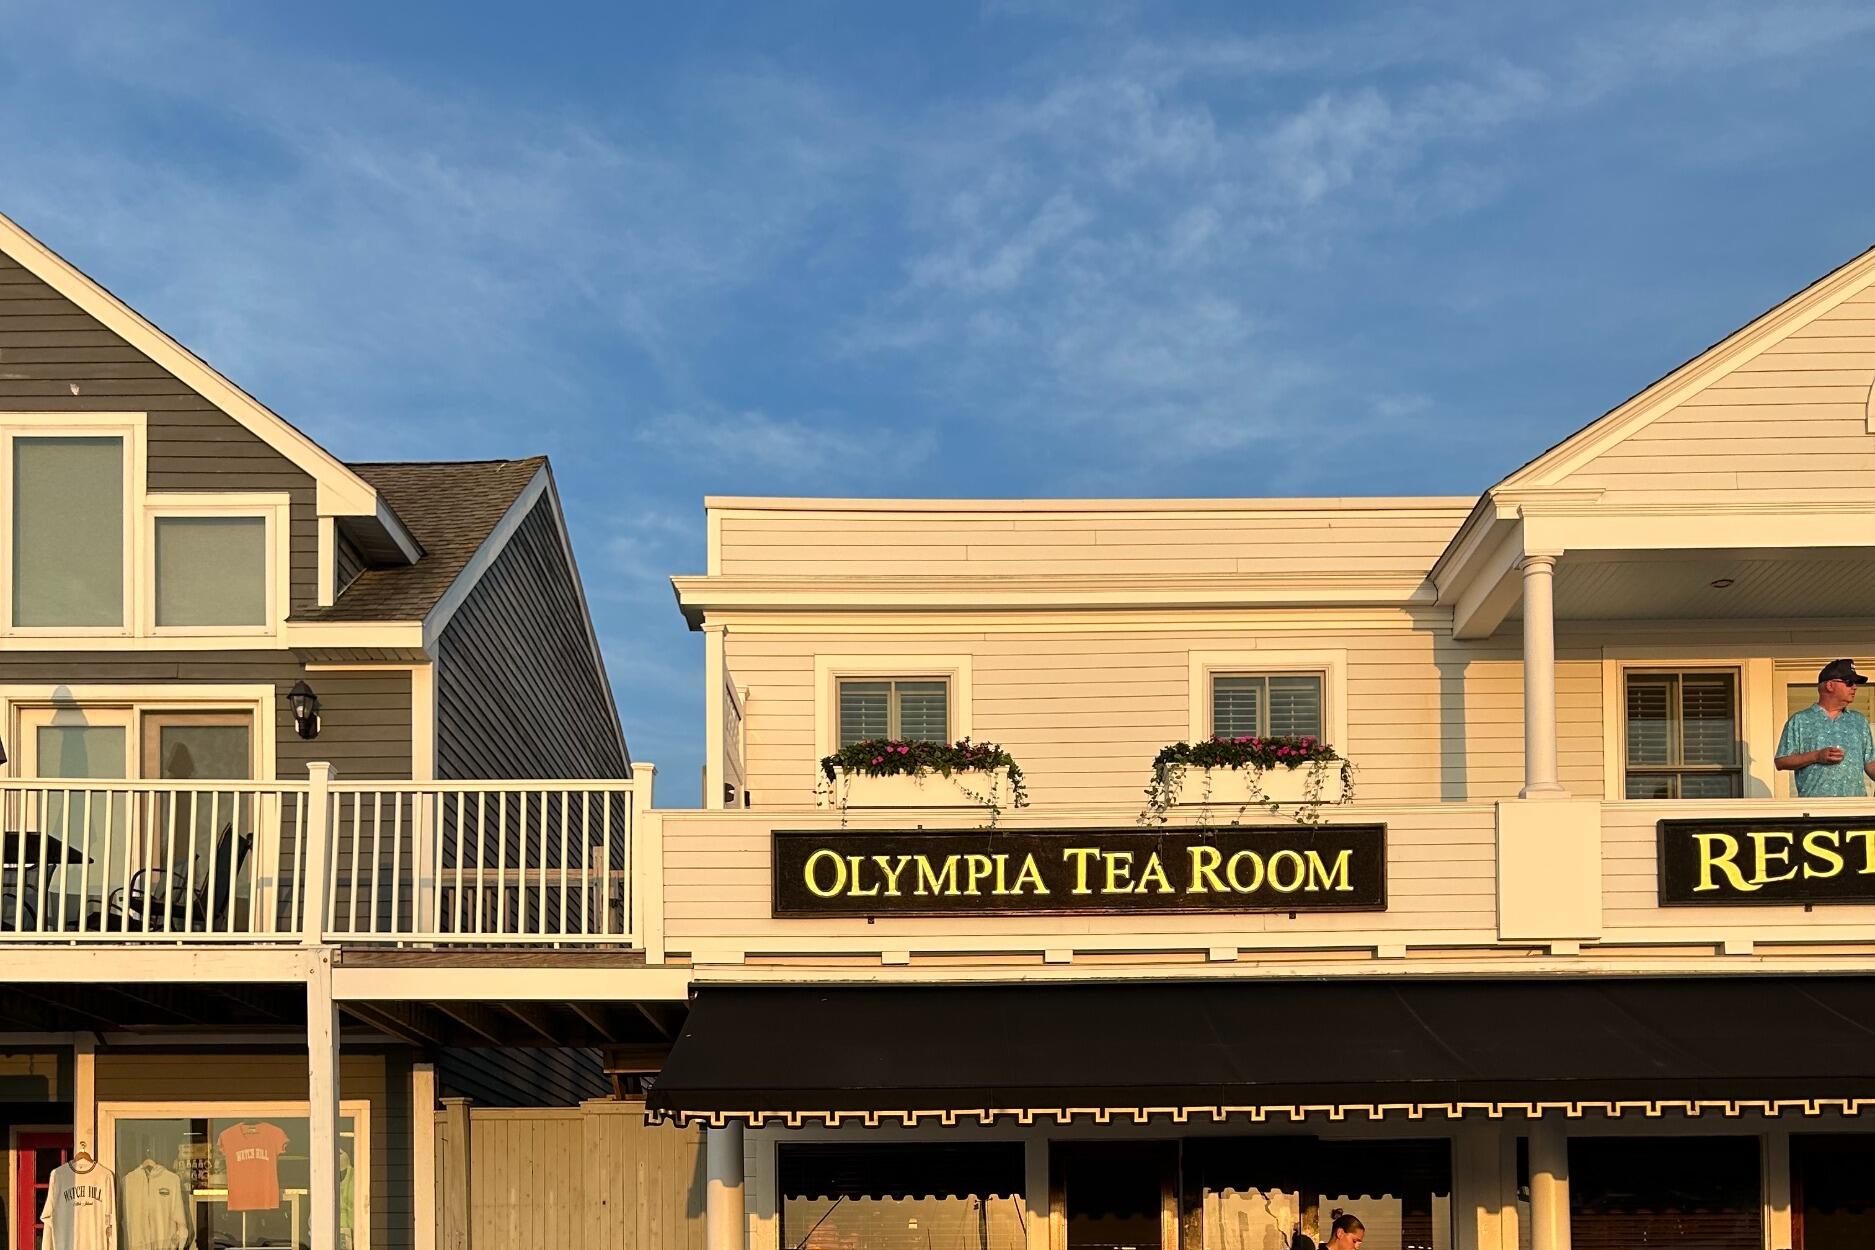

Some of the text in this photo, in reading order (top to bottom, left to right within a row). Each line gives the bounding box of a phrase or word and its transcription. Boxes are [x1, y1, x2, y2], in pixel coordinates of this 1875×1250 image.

[803, 846, 1354, 898] OLYMPIA TEA ROOM
[63, 1185, 103, 1203] WATCH HILL
